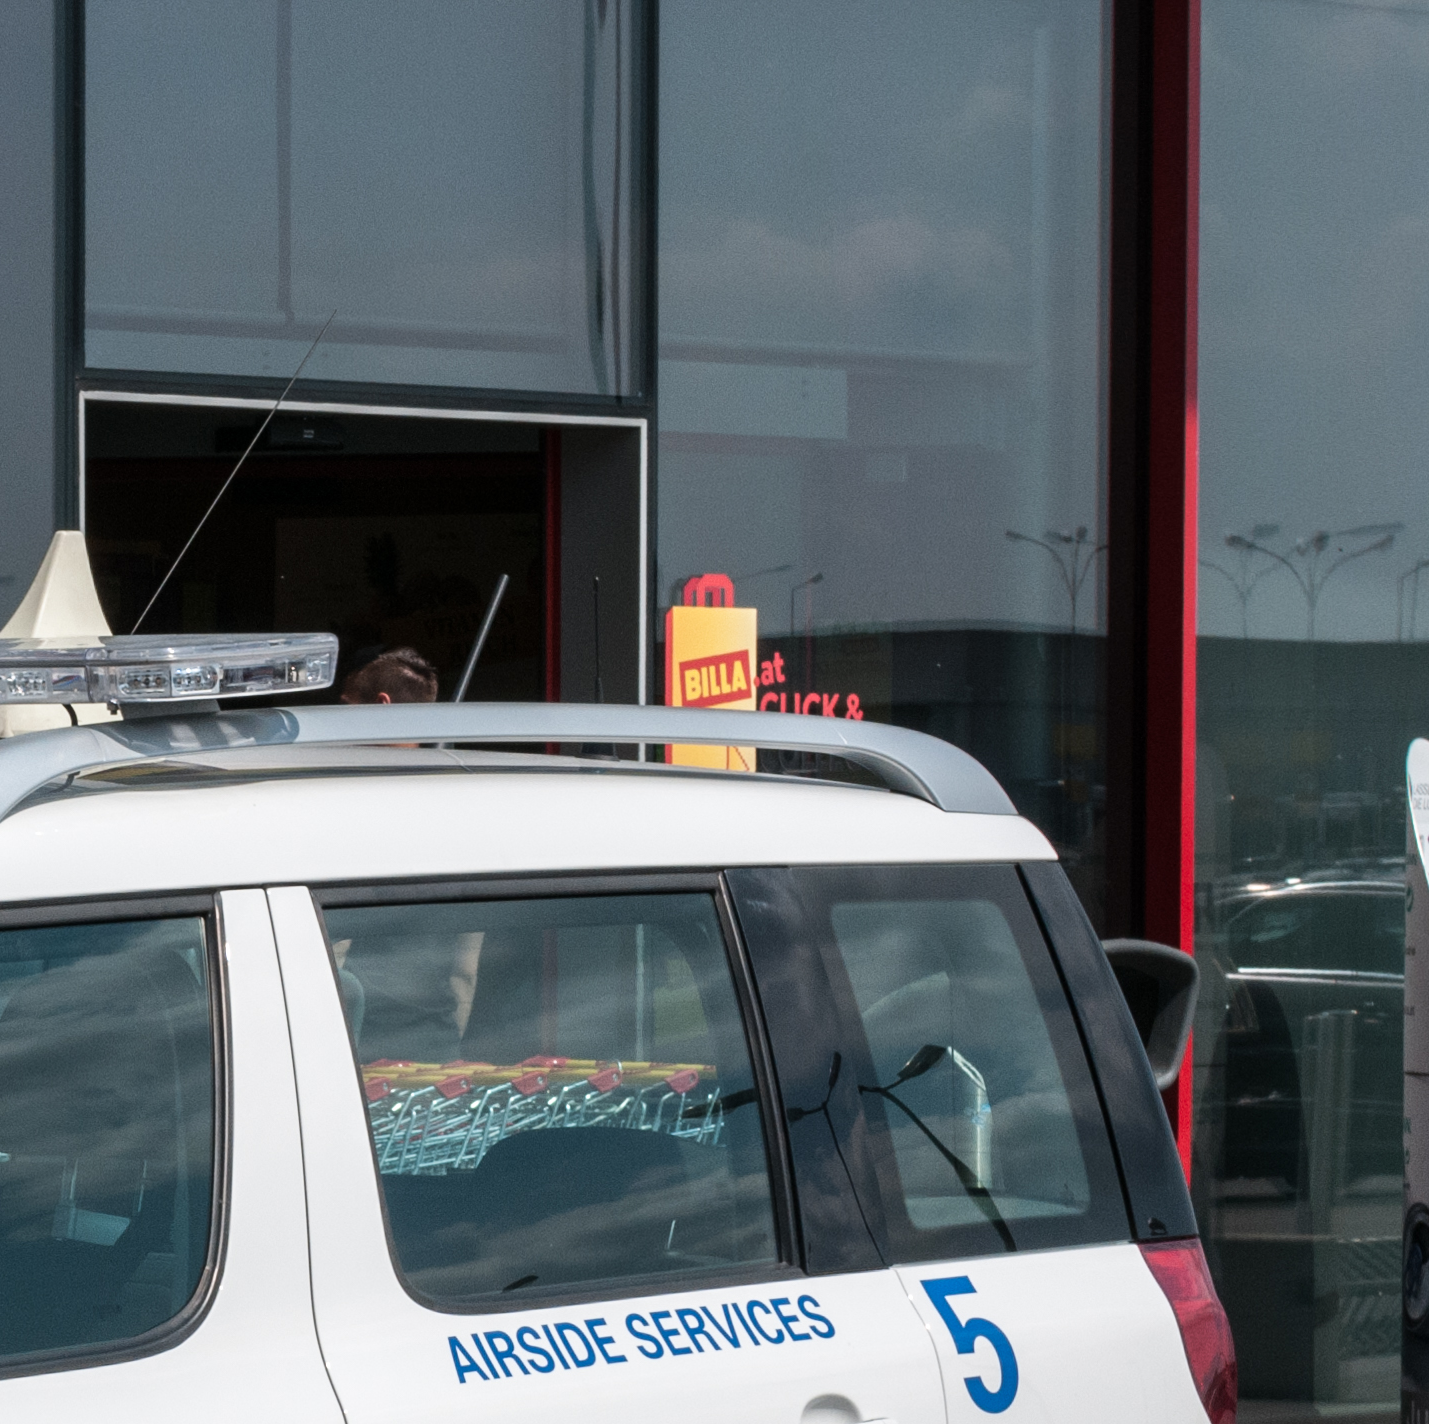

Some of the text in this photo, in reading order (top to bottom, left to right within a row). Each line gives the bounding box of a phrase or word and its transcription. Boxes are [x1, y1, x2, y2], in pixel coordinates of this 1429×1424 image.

[684, 660, 748, 701] BILLA
[845, 693, 864, 721] &
[447, 1294, 836, 1384] AIRSIDE SERVICES
[920, 1275, 1019, 1414] 5
